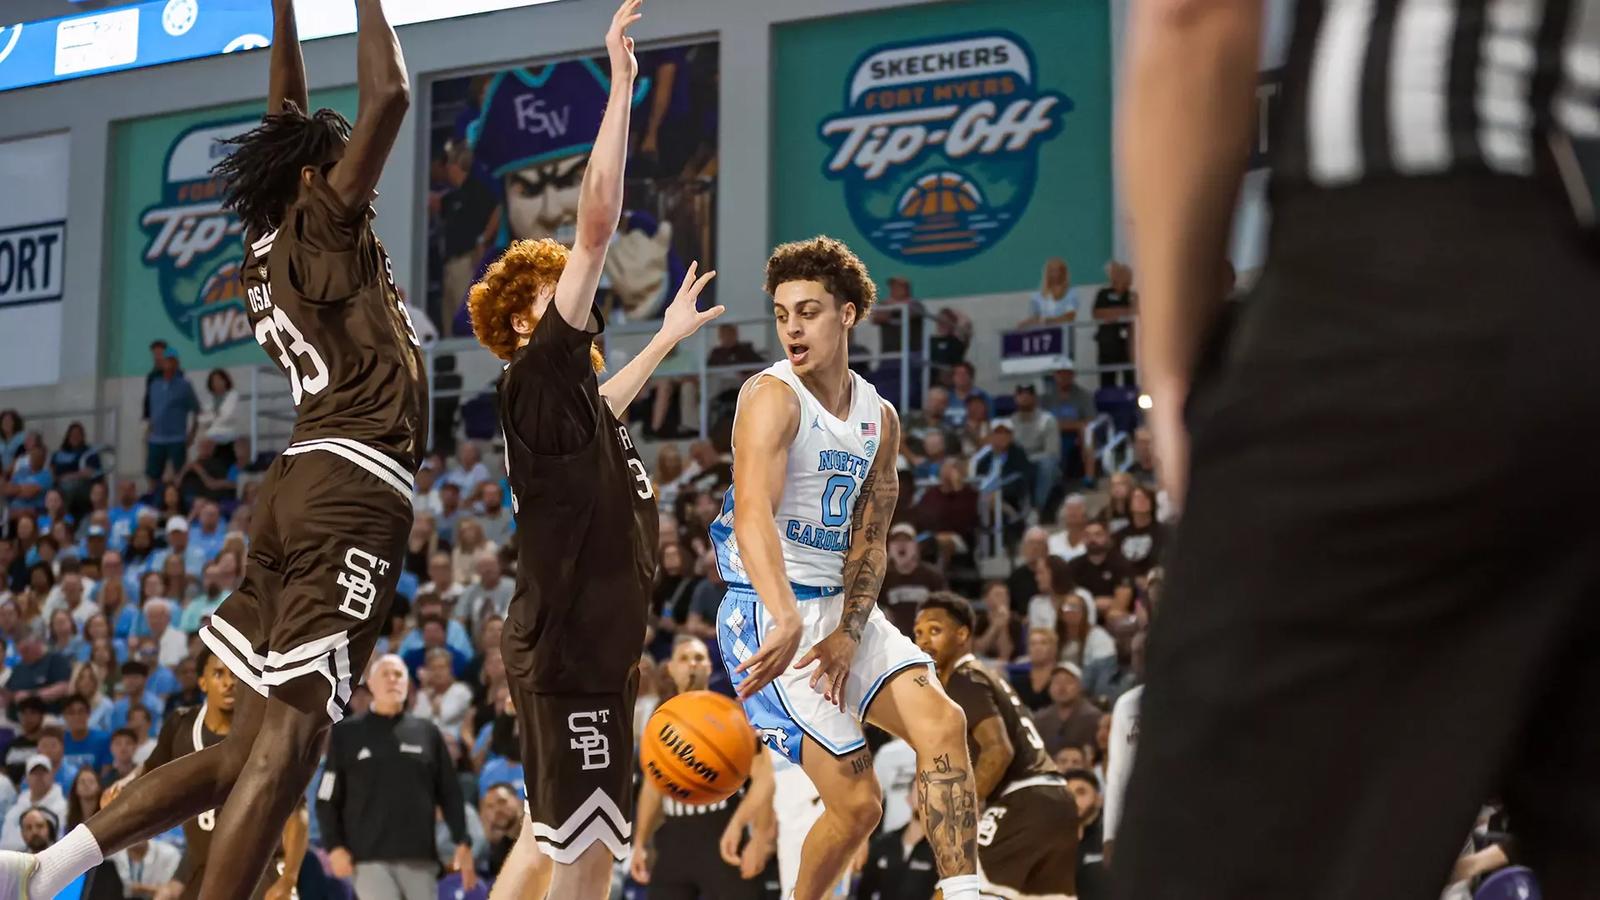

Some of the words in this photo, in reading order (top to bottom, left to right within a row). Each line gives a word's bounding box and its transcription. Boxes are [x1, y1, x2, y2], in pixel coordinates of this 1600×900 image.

[870, 45, 1010, 80] SKECHERS
[513, 92, 571, 139] FSW
[864, 86, 926, 111] FORT
[932, 75, 1016, 101] MYERS
[821, 96, 1059, 181] Tip-Off
[247, 281, 272, 313] OSA
[255, 303, 329, 406] 33
[818, 449, 870, 480] NORTH
[821, 473, 857, 528] 0
[658, 722, 720, 785] Wilson
